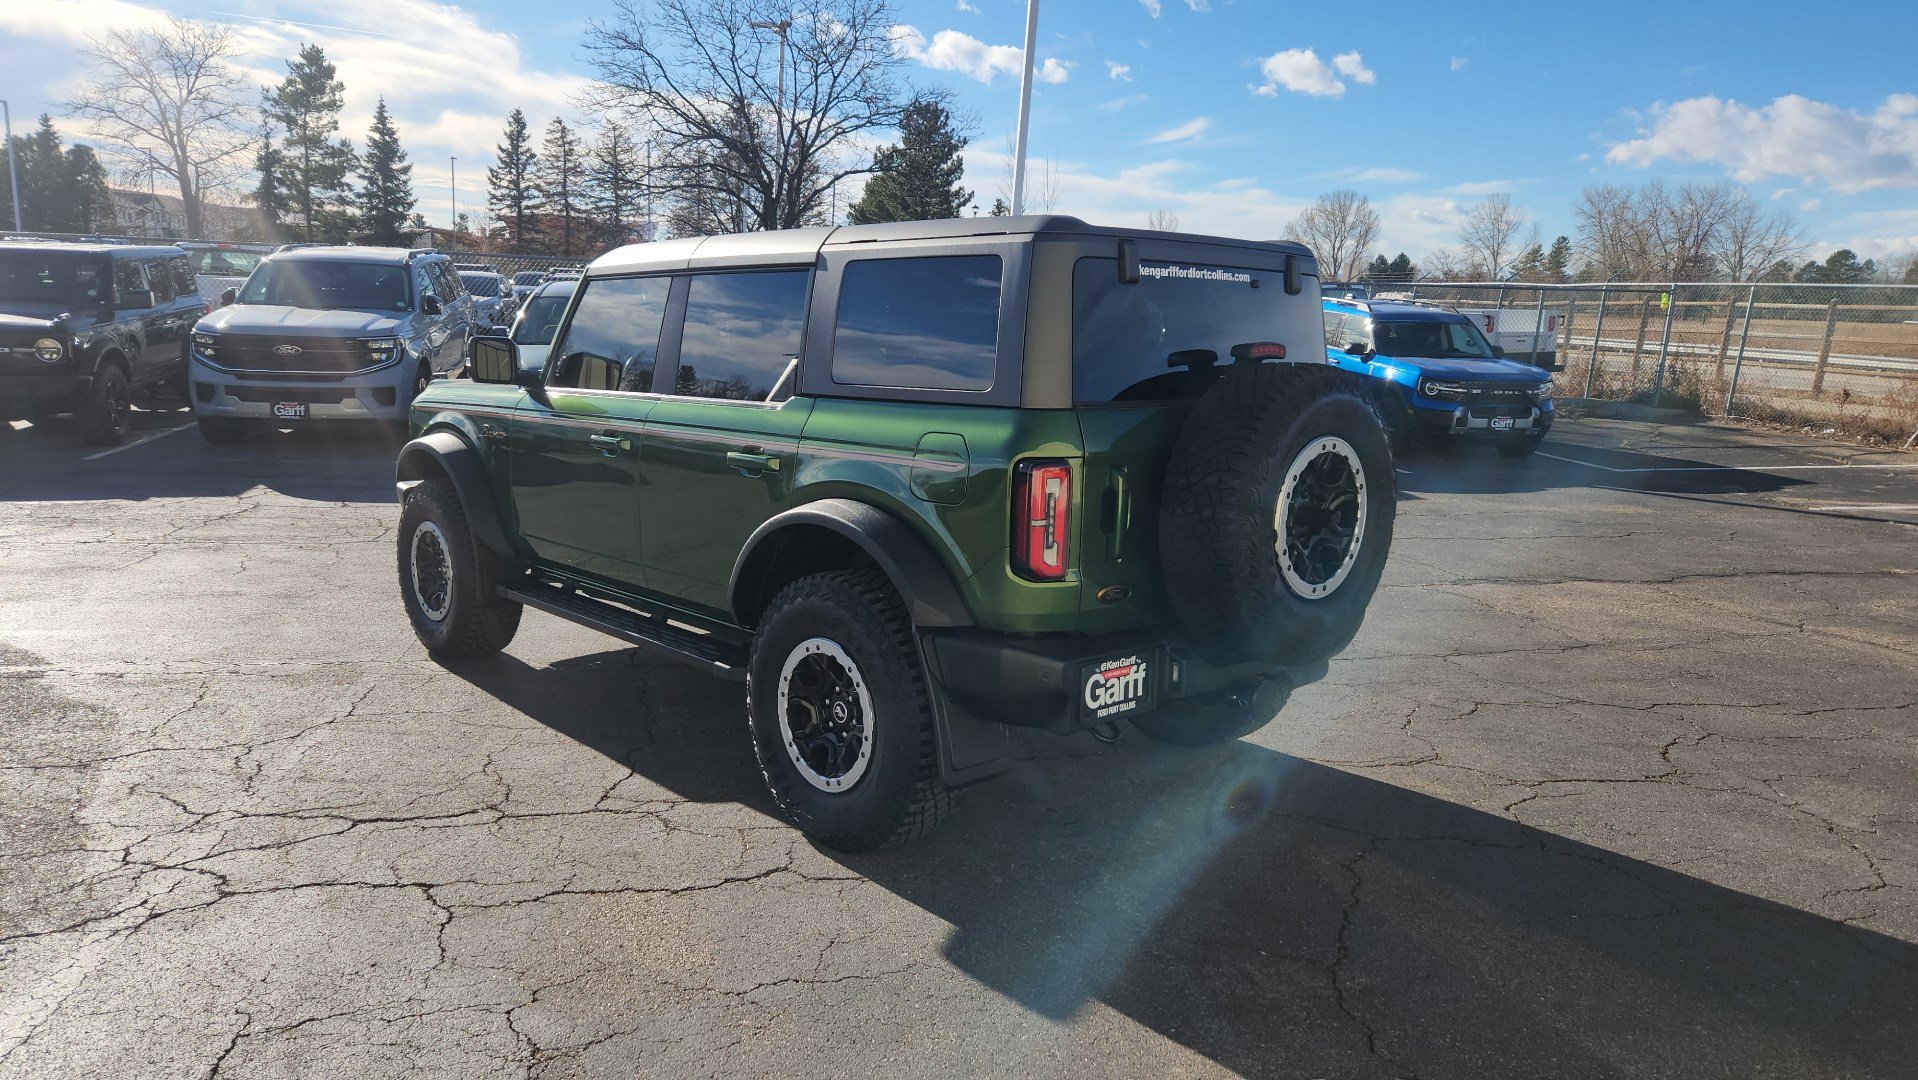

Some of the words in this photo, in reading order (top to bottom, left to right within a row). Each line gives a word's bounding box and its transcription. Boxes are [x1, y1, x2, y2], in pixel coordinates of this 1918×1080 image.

[274, 404, 305, 416] Garff
[1491, 418, 1514, 428] Garff
[1106, 660, 1120, 671] Ken
[1120, 655, 1137, 668] Garff
[1084, 663, 1147, 710] Garff
